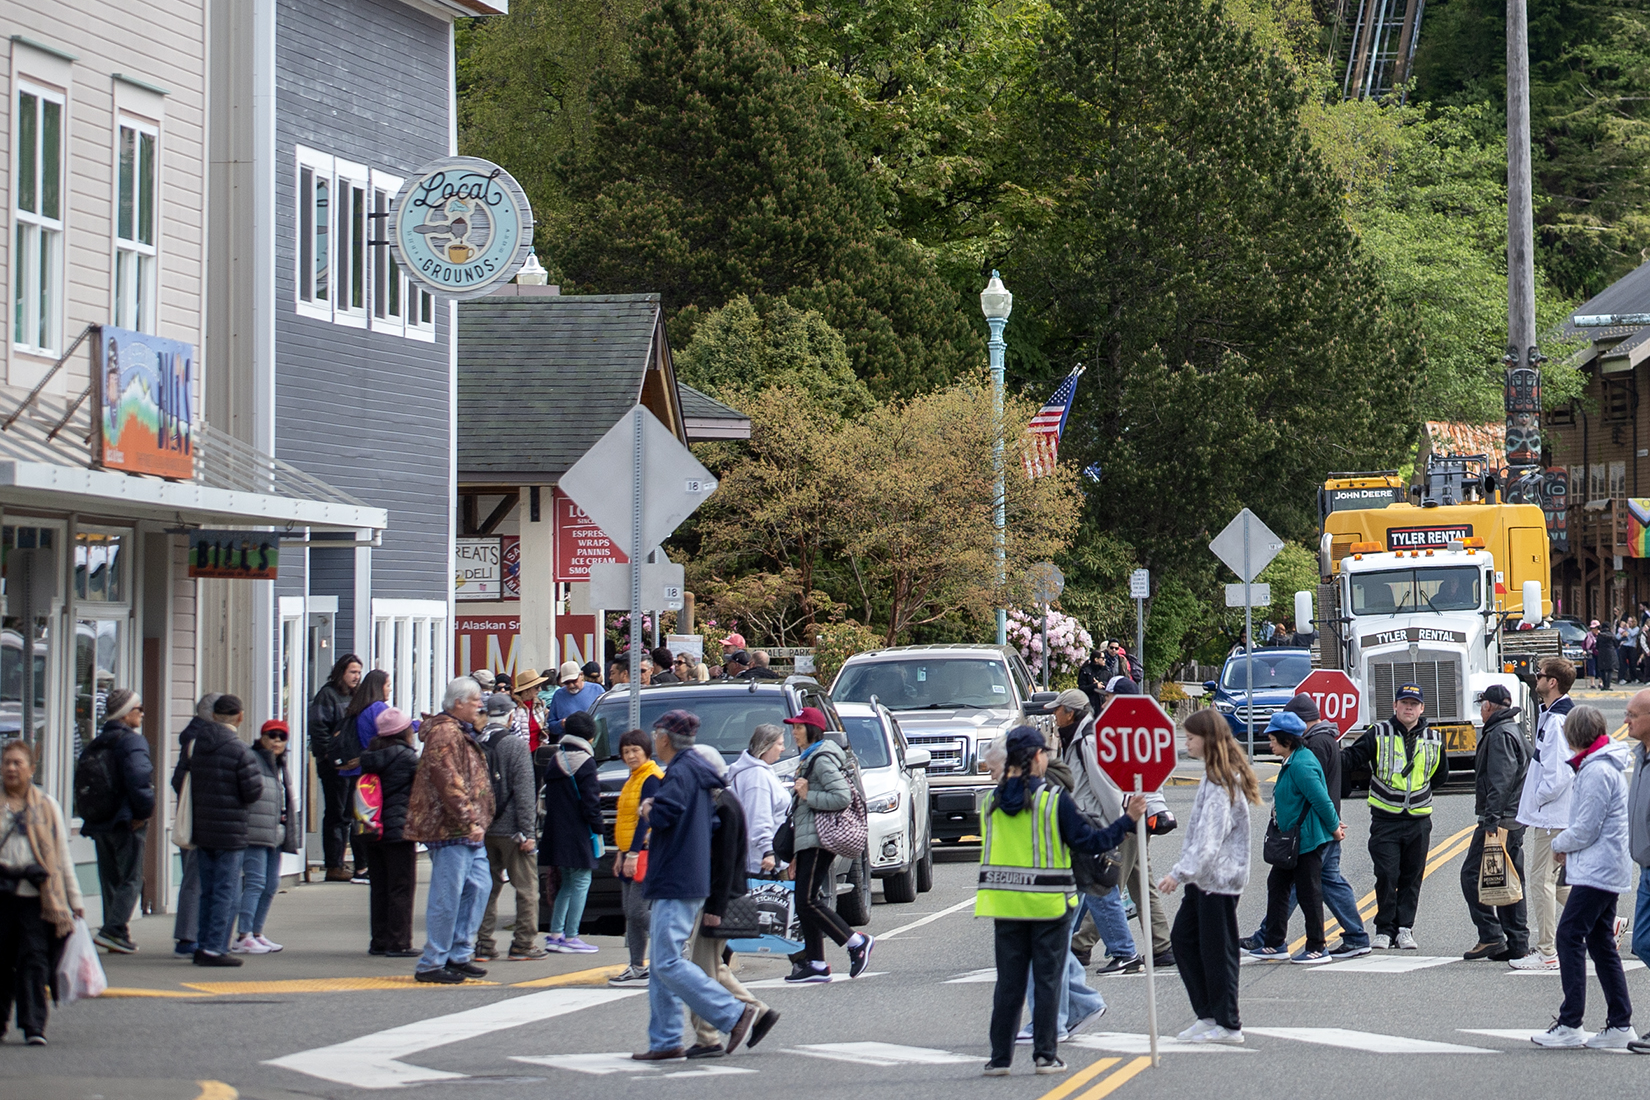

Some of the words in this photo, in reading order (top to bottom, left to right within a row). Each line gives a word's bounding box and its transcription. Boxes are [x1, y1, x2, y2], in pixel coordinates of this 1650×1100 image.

[414, 168, 502, 209] Local
[422, 259, 495, 282] GROUNDS
[688, 481, 699, 491] 18
[1335, 491, 1360, 500] JOHN
[1361, 489, 1393, 499] DEERE
[572, 530, 610, 538] ESPRESS
[1391, 531, 1426, 546] TYLER
[578, 539, 610, 547] WRAPS
[456, 545, 499, 565] REATS
[577, 548, 611, 556] PANINIS
[465, 567, 493, 579] DELI
[667, 588, 678, 598] 18
[462, 620, 506, 631] Alaskan
[1376, 630, 1407, 644] TYLER
[1418, 629, 1456, 642] RENTAL
[789, 648, 811, 657] PARK
[1306, 692, 1357, 720] TOP
[1100, 726, 1172, 763] STOP
[985, 870, 1038, 885] SECURITY
